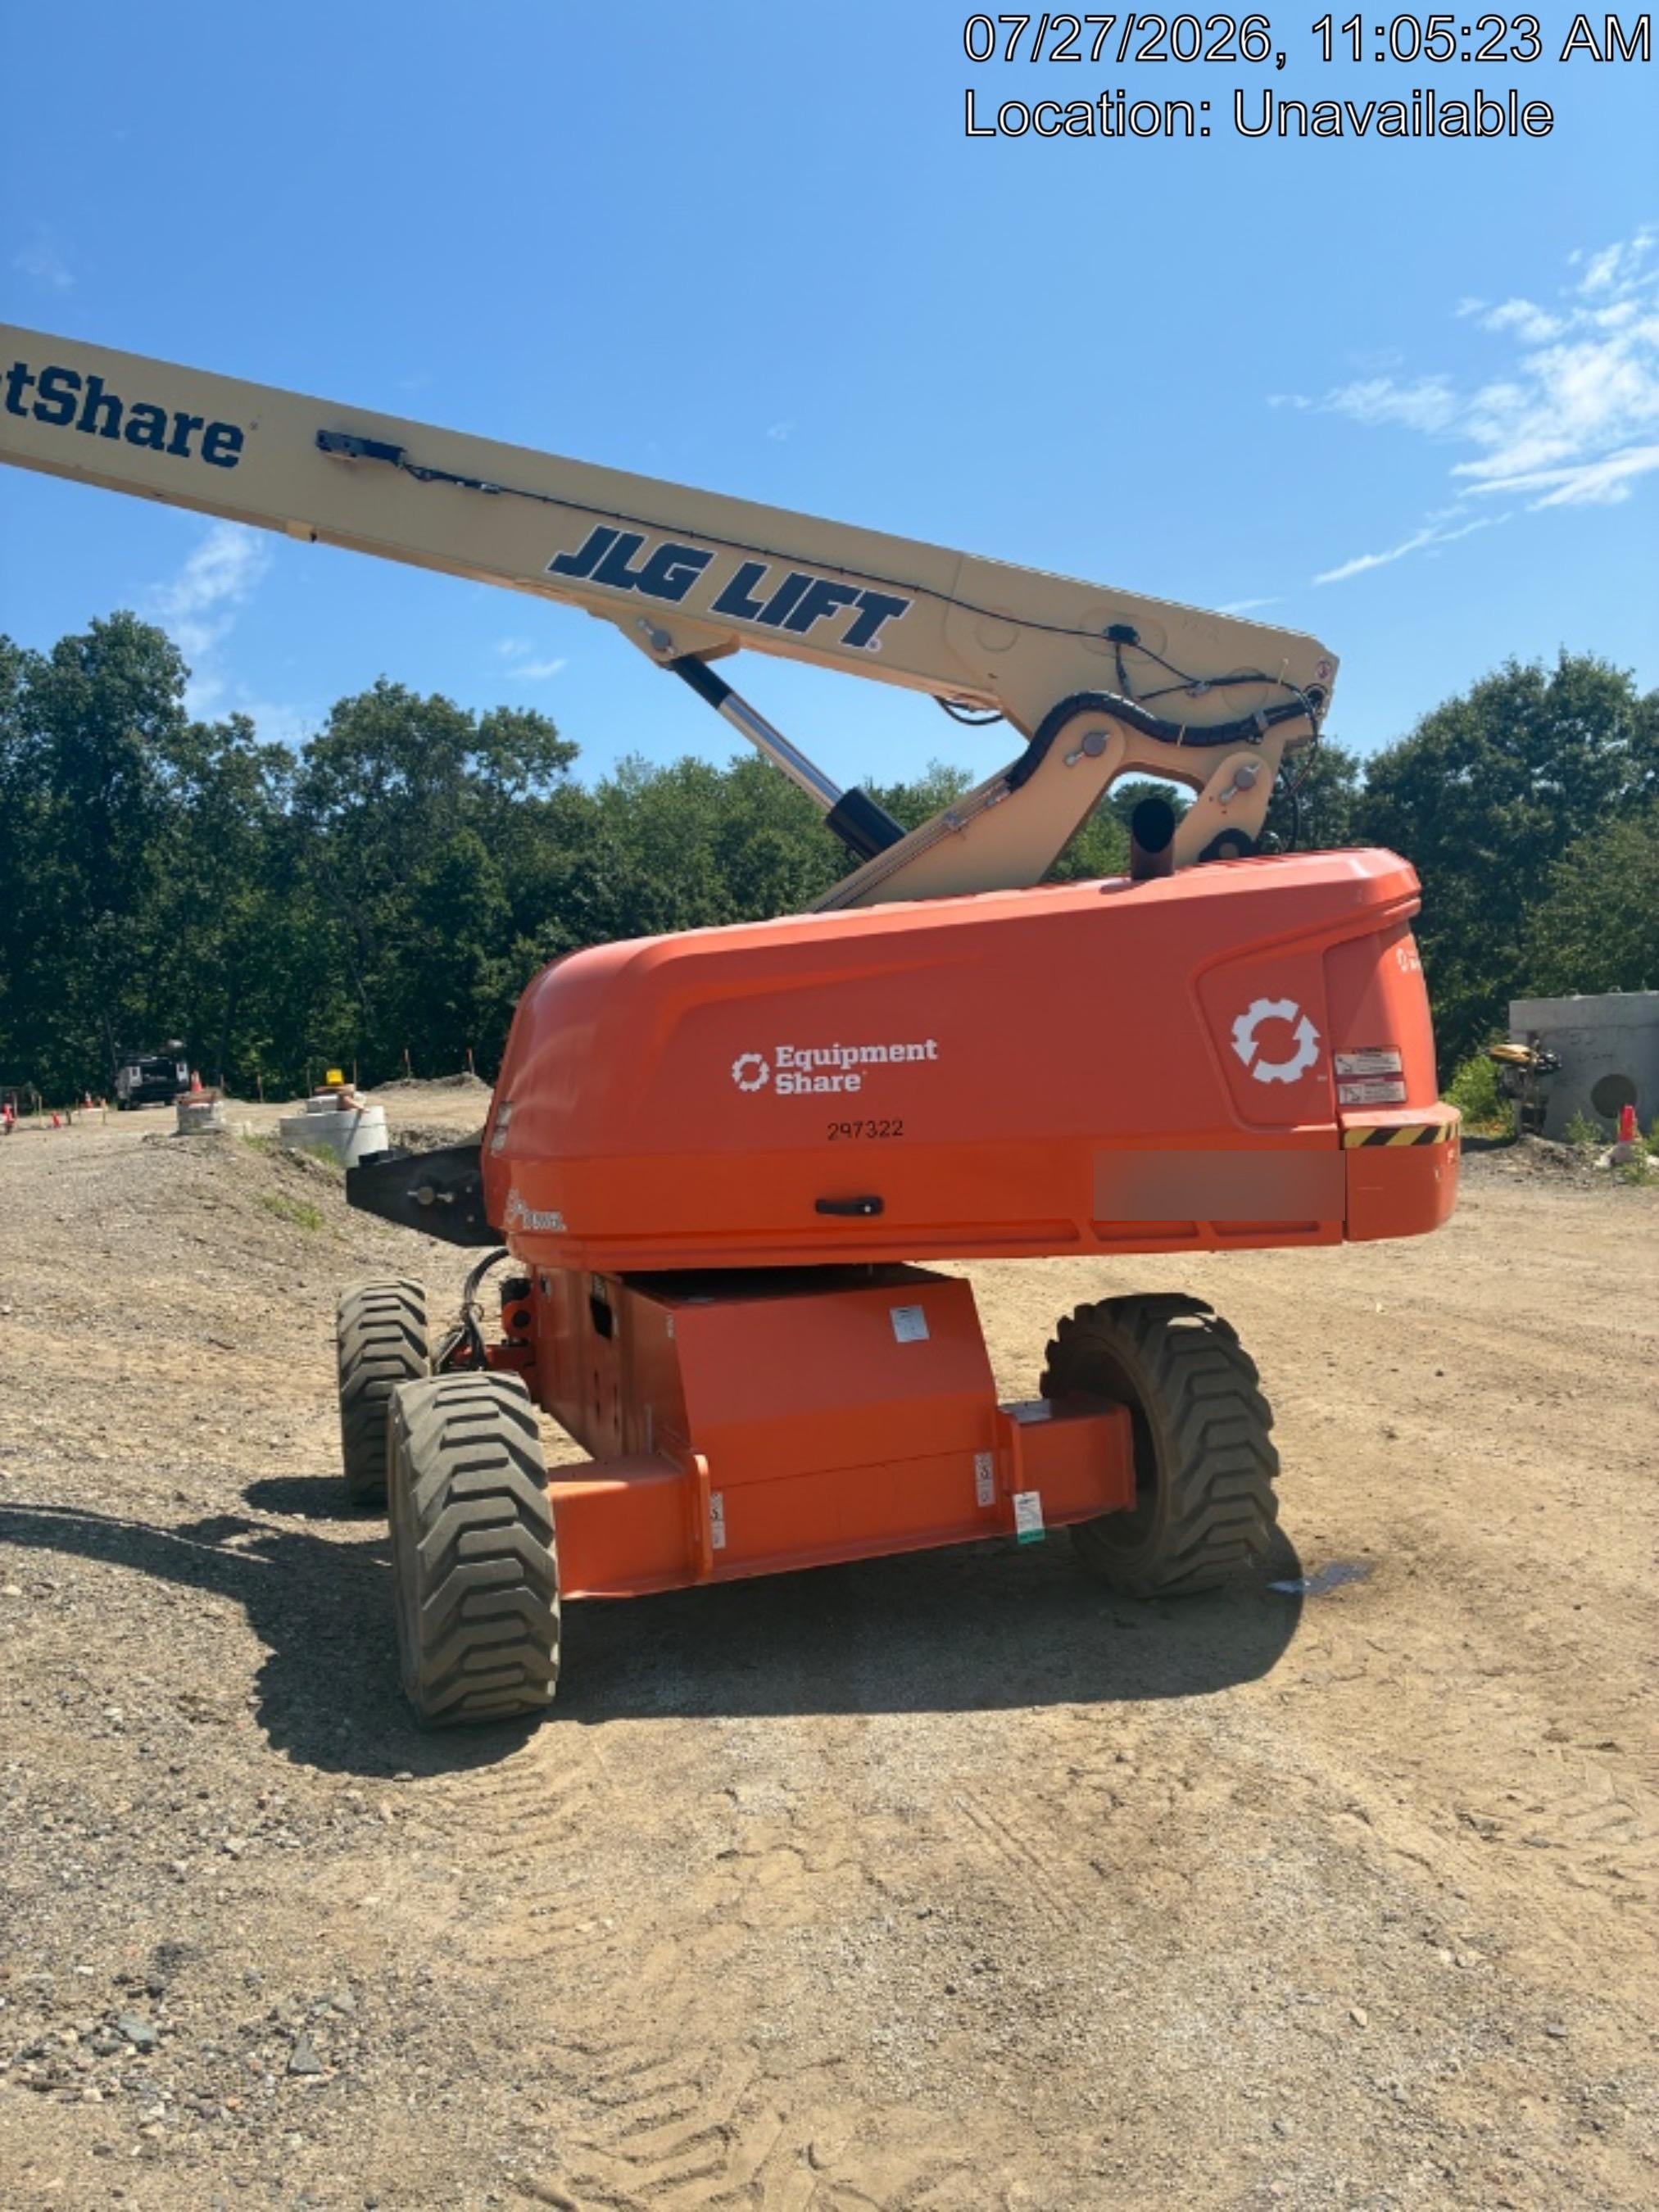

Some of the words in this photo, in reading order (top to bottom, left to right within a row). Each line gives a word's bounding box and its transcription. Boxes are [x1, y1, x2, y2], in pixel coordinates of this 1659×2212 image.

[0, 360, 244, 469] tShare
[546, 524, 717, 605] JLG
[709, 560, 915, 648] LIFT
[775, 1039, 938, 1072] Equipment
[775, 1072, 861, 1095] Share
[827, 1119, 904, 1141] 297322
